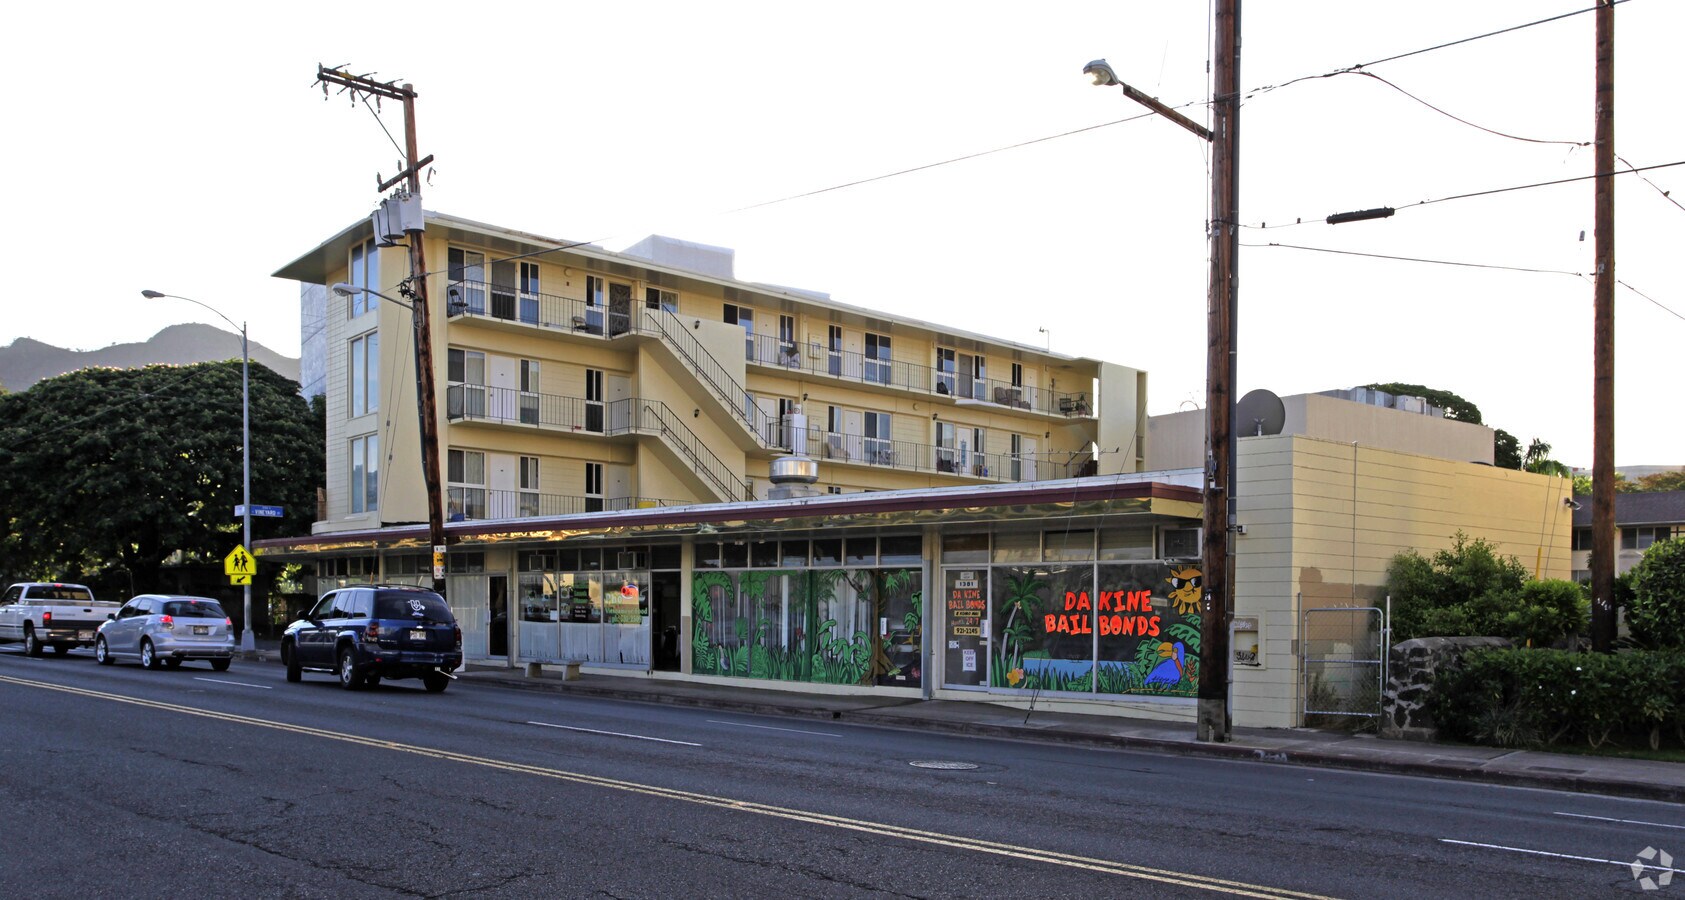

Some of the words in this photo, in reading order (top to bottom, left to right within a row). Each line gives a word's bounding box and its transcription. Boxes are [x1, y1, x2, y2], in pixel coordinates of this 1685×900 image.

[953, 591, 962, 599] DA
[964, 590, 980, 599] KINE
[1064, 591, 1092, 611] DA
[1098, 590, 1153, 612] KINE
[948, 600, 964, 609] BAIL
[966, 600, 986, 609] BONDS
[1044, 614, 1092, 635] BAIL
[1098, 615, 1160, 637] BONDS
